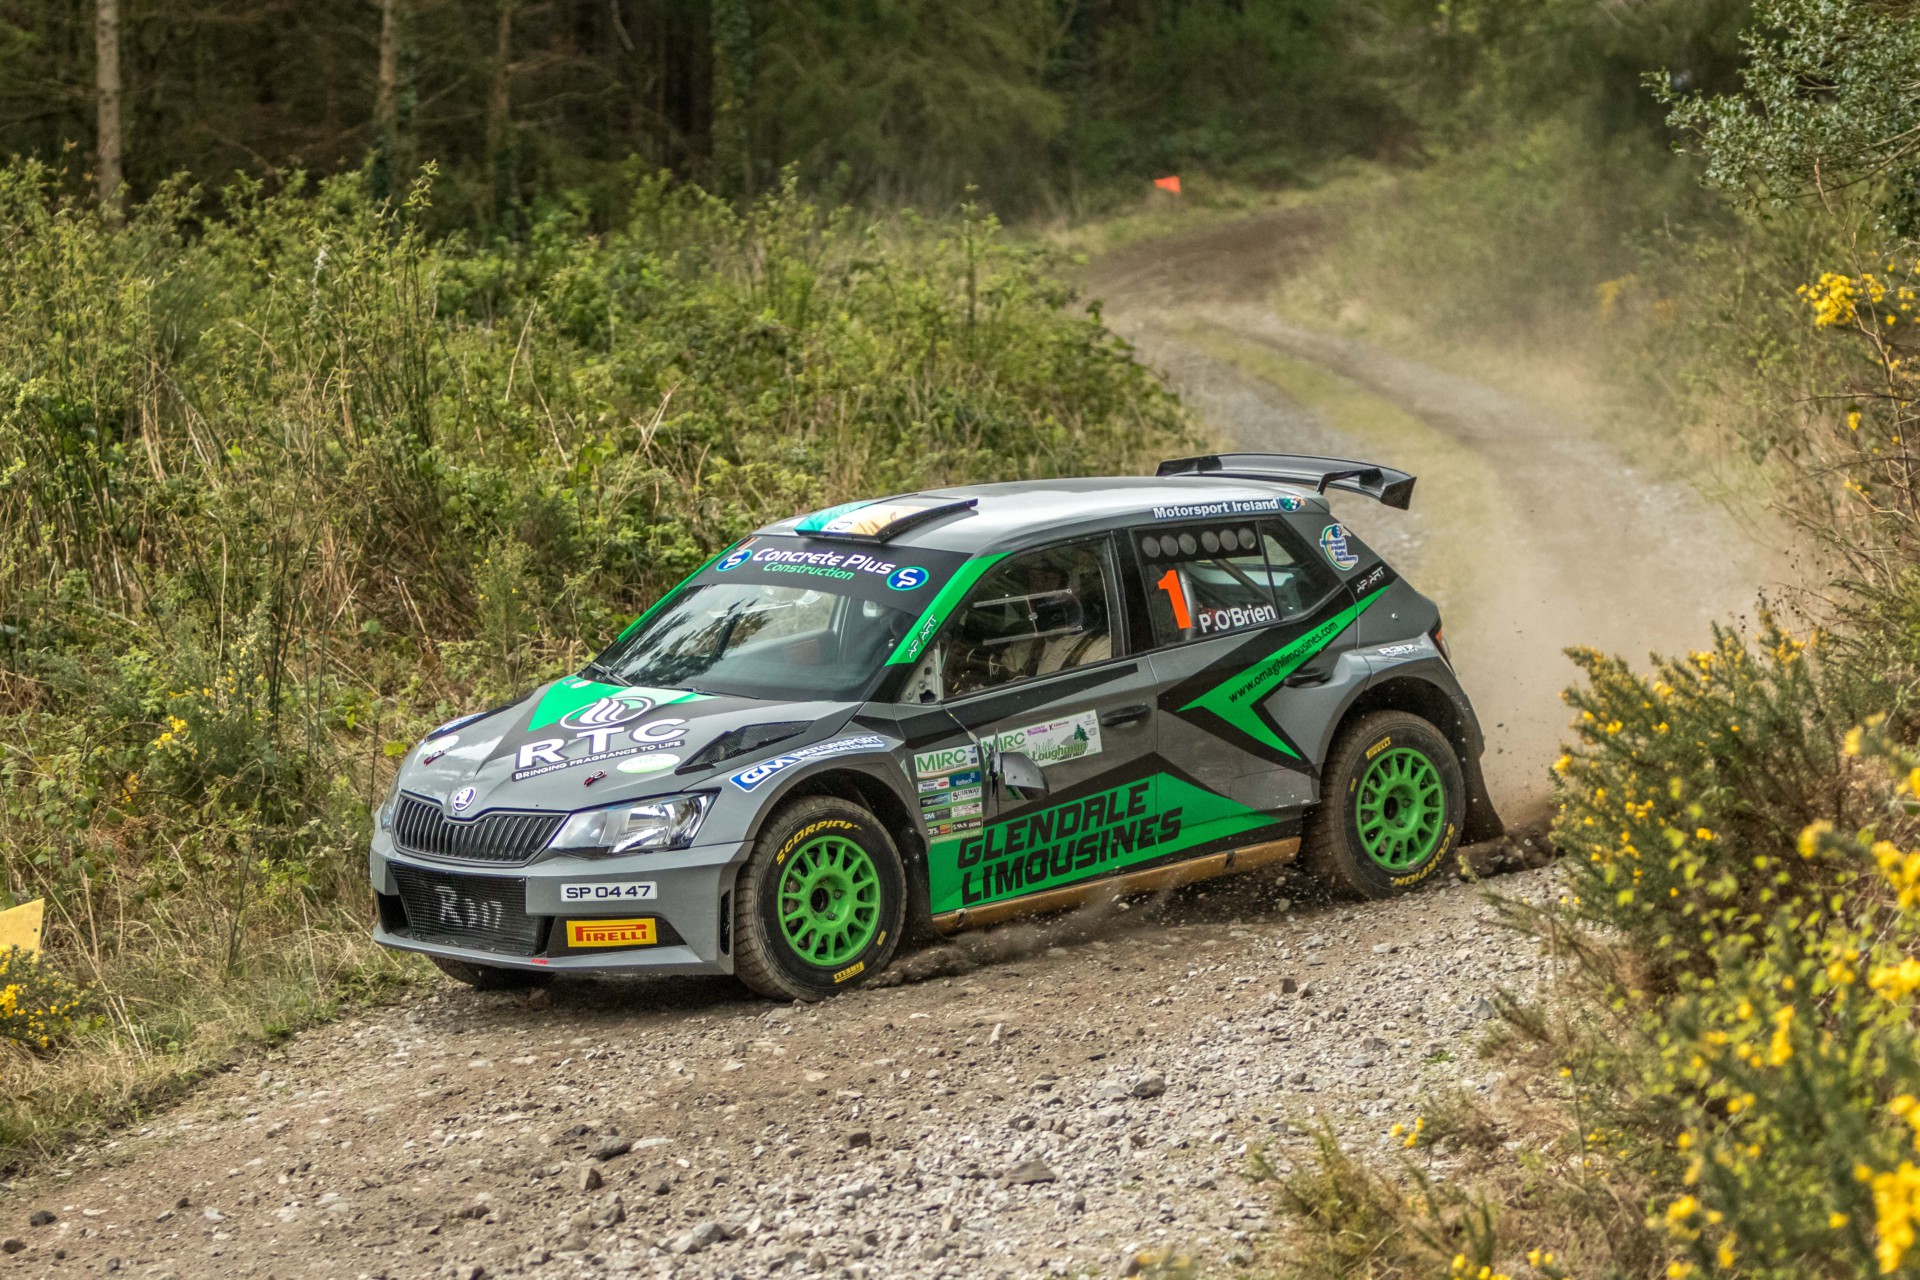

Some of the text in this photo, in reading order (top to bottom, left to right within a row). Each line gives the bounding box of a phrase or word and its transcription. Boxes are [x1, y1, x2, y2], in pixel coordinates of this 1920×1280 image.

[1153, 498, 1279, 519] Motorsport Ireland
[752, 548, 896, 575] Concrete Plus
[763, 561, 855, 580] Construction
[1157, 569, 1193, 629] 1
[1228, 620, 1339, 704] www.omaghlimousines.com
[518, 717, 688, 769] RTC
[791, 735, 884, 759] MOTORSPORT
[515, 762, 568, 781] BRINGING
[569, 747, 638, 768] FRAGRANCE
[640, 744, 657, 752] TO
[658, 739, 682, 750] LIFE
[916, 748, 967, 773] MIRC
[957, 782, 1150, 870] GLENDALE
[961, 806, 1183, 906] LIMOUSINES
[566, 887, 591, 899] SP
[575, 923, 647, 942] PIRELLI
